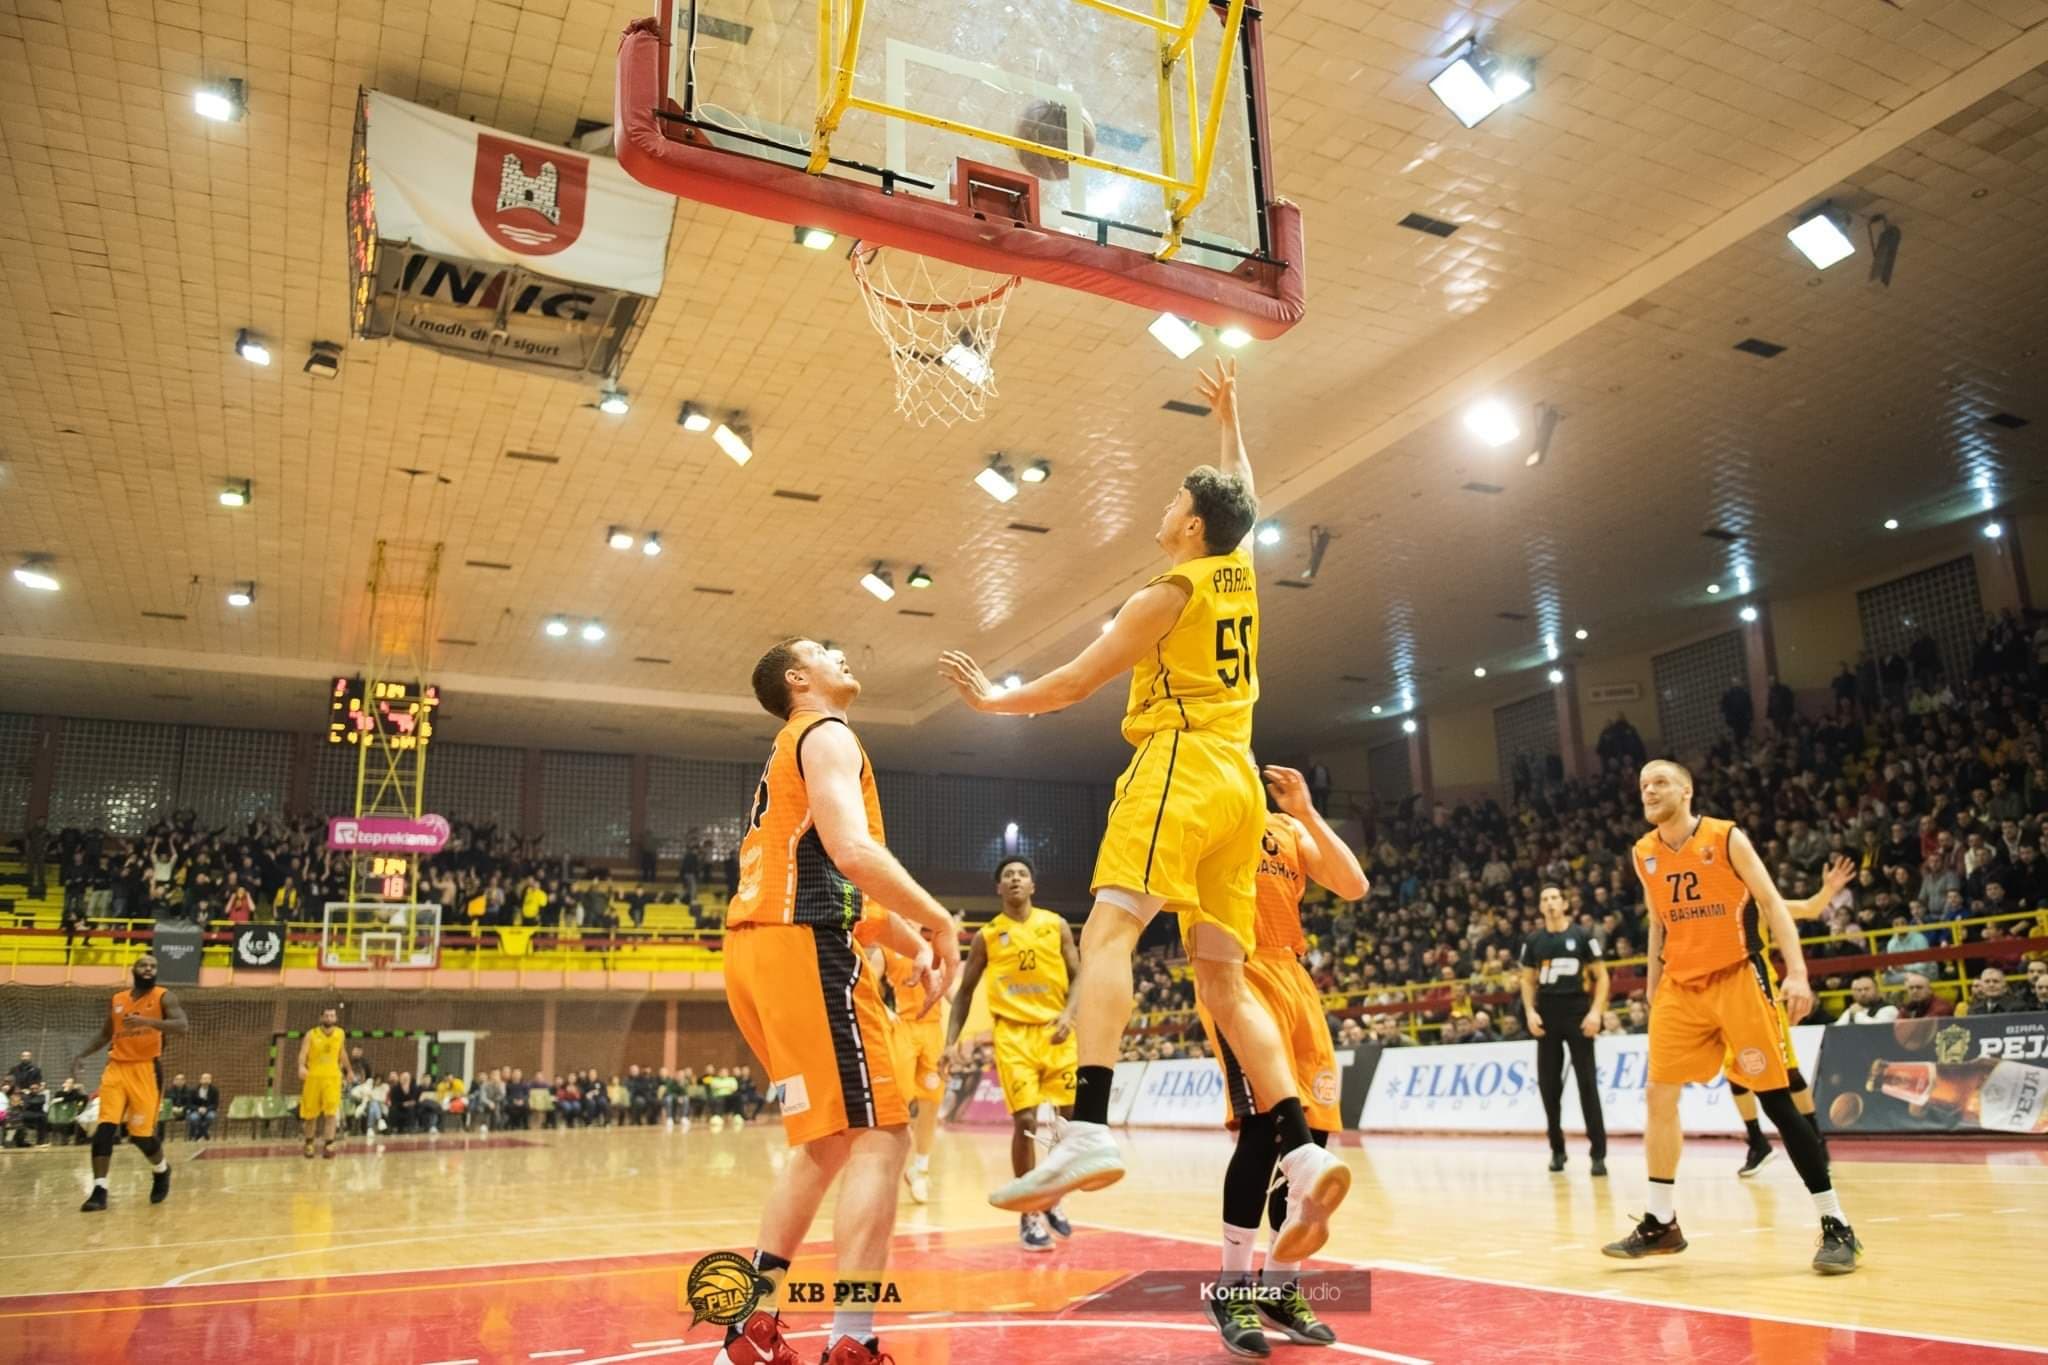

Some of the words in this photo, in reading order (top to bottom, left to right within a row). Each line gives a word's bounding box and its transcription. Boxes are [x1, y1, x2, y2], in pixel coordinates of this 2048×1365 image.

[513, 339, 561, 357] sigurt
[1667, 871, 1701, 903] 72
[1018, 949, 1037, 971] 23
[2005, 1023, 2046, 1035] BIRRA
[1405, 1058, 1529, 1098] ELKOS
